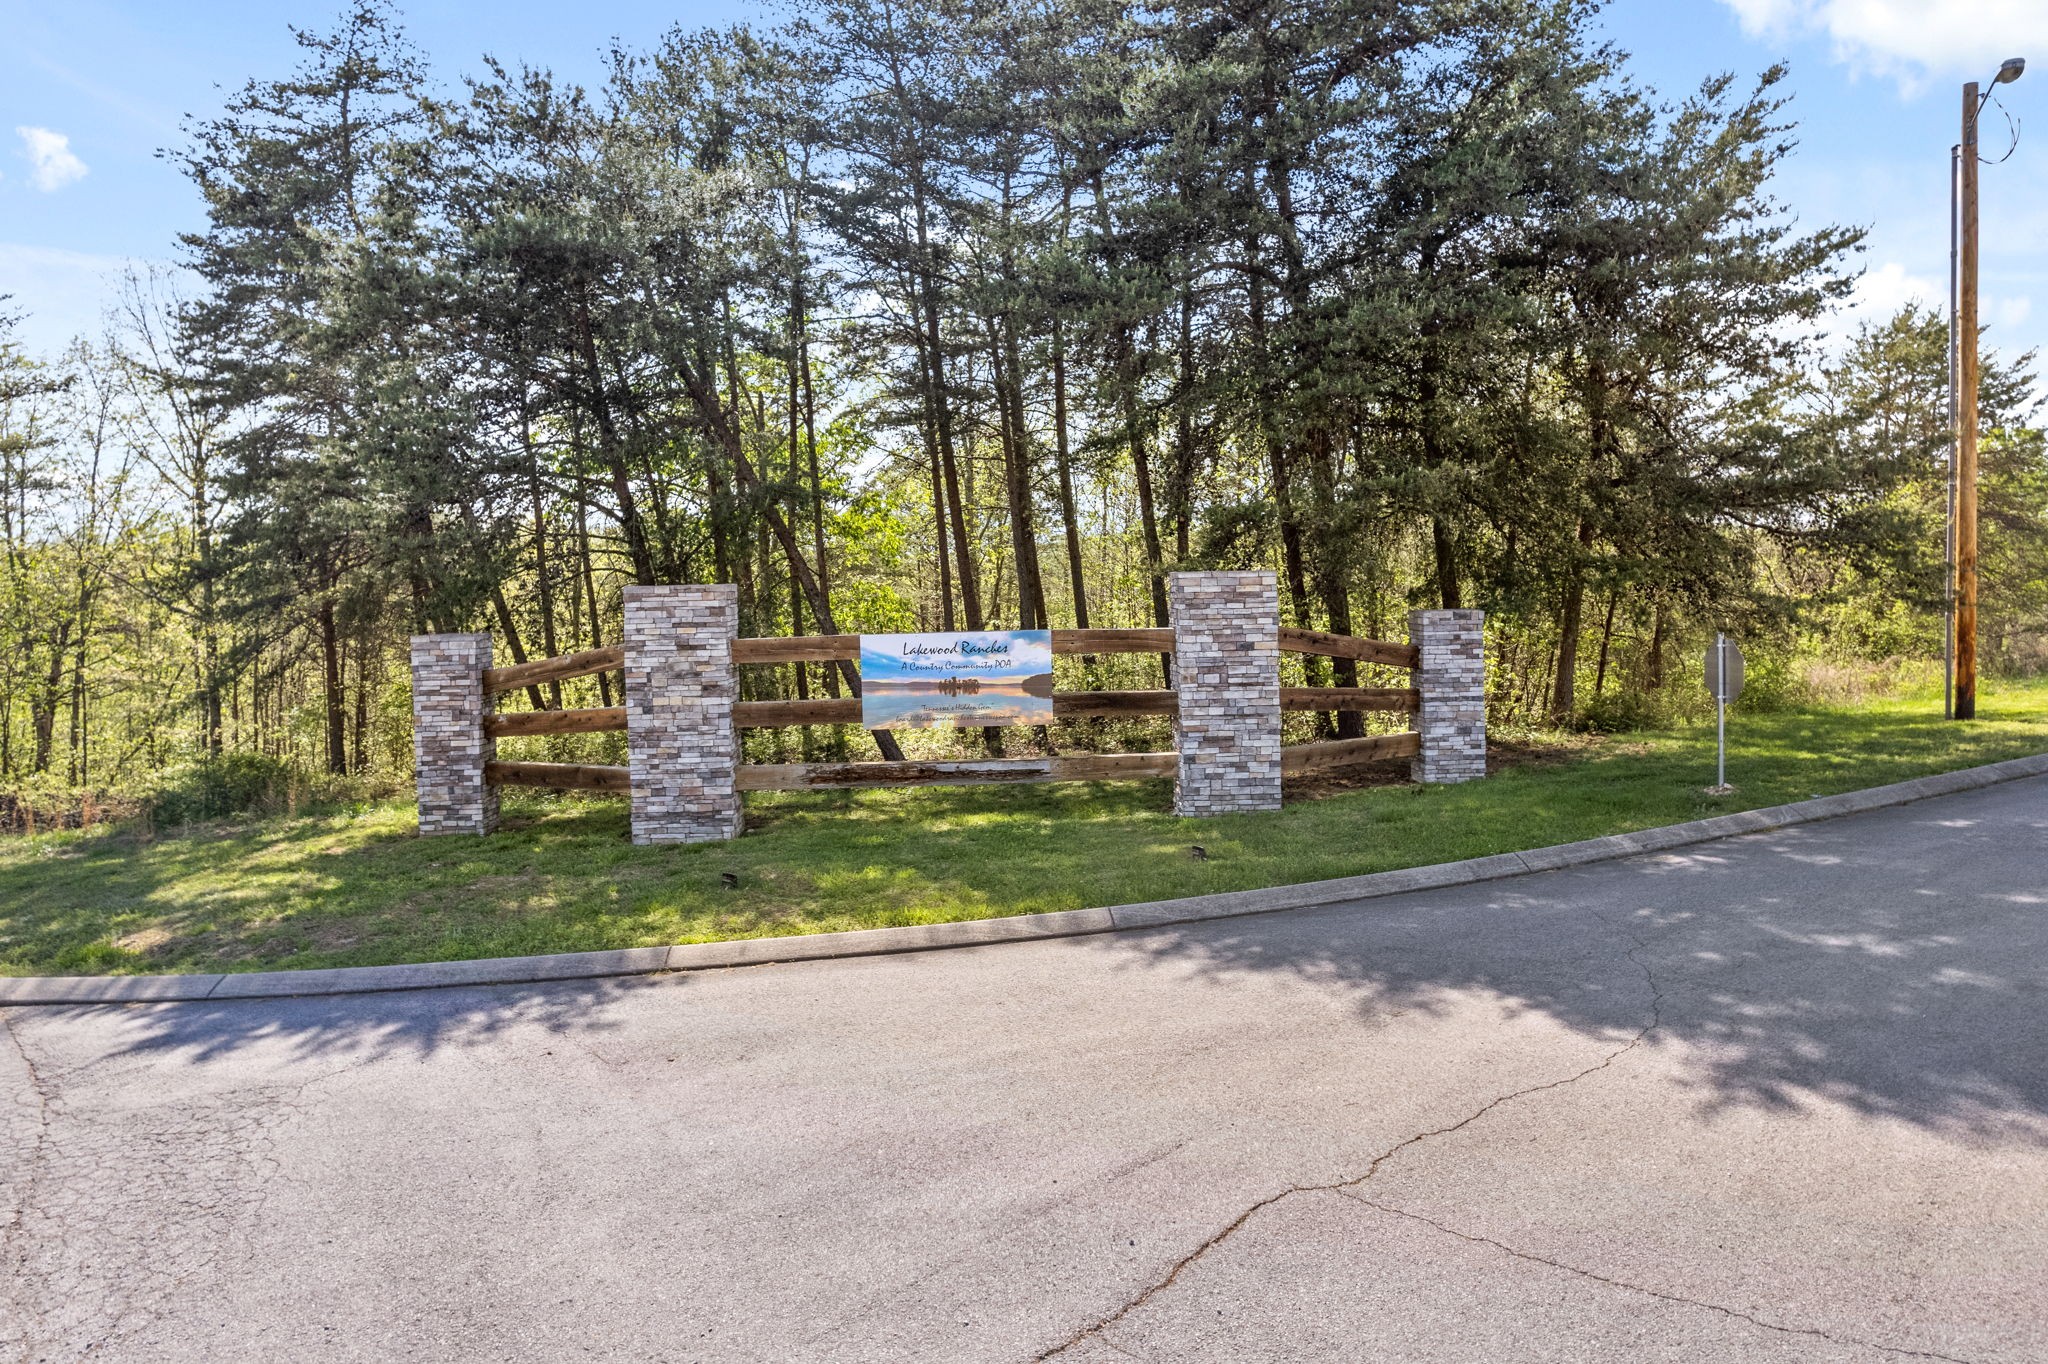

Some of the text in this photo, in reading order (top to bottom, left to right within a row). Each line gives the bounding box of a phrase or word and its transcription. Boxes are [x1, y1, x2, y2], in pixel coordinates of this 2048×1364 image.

[903, 640, 1009, 656] Lakewood Ranches
[901, 659, 1012, 673] A Country Community POA
[955, 702, 978, 711] Hidden
